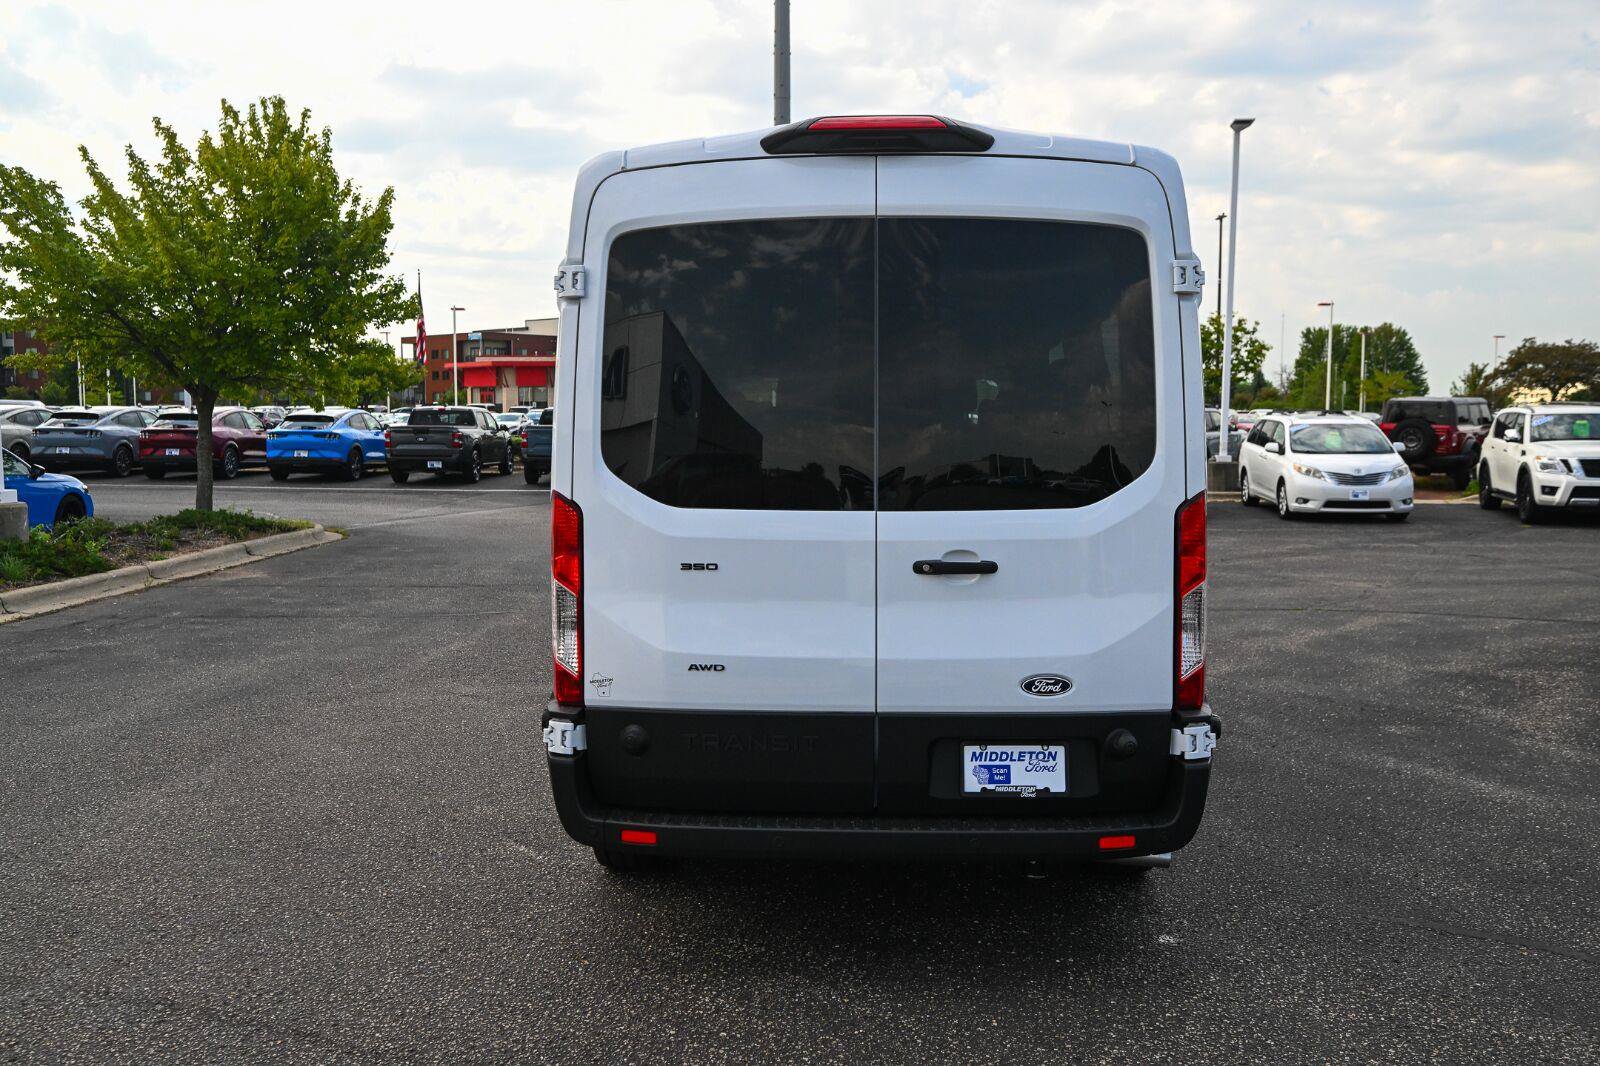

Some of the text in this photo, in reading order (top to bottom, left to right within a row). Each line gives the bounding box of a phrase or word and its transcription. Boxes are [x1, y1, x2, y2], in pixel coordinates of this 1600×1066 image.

[680, 562, 719, 571] 350
[688, 663, 725, 671] AWD
[1031, 679, 1062, 693] Ford
[680, 733, 819, 752] TRANSIT
[970, 751, 1058, 762] MIDDLETON
[1024, 759, 1058, 773] Ford
